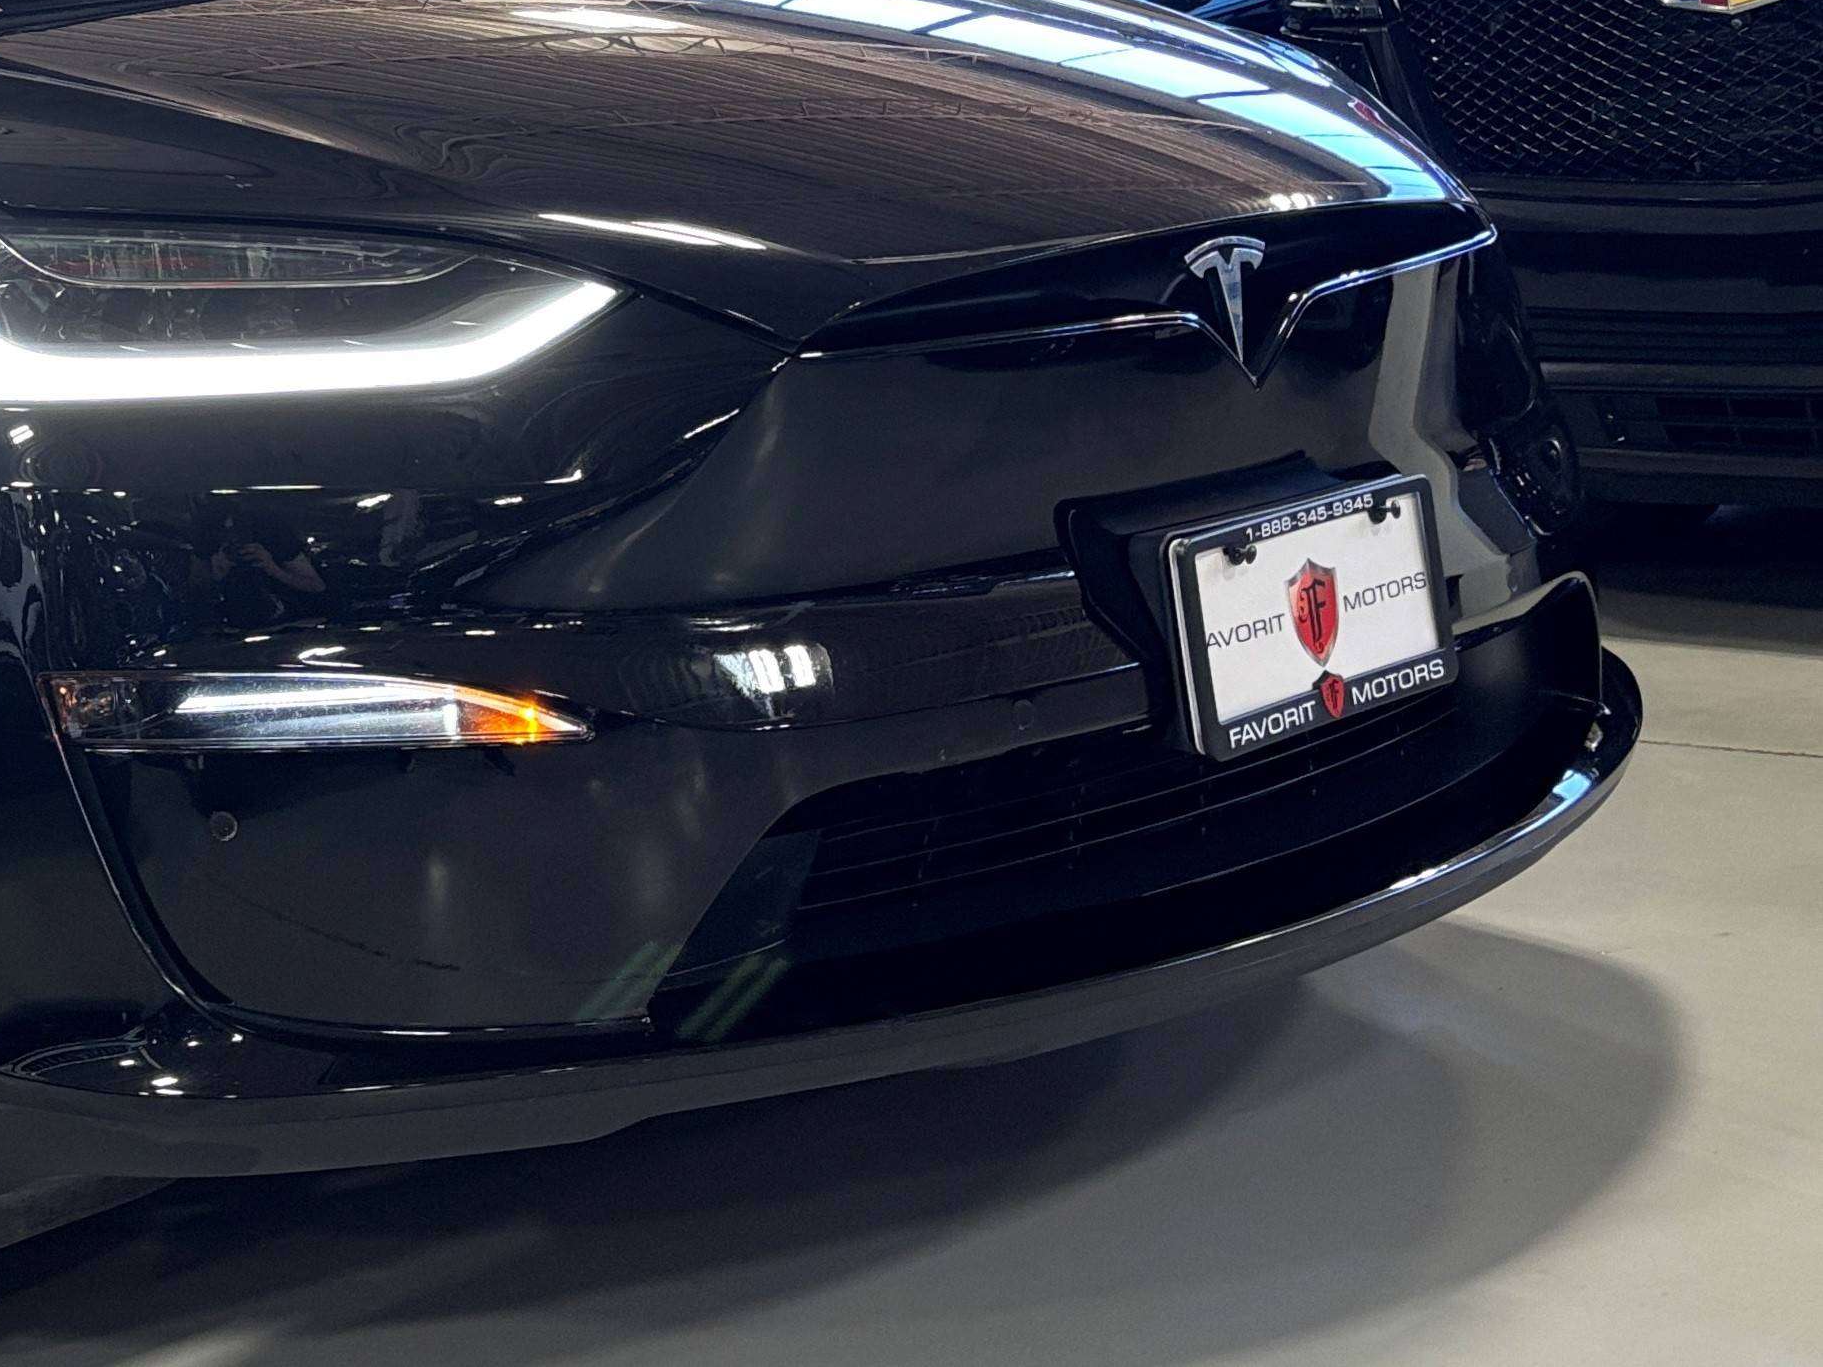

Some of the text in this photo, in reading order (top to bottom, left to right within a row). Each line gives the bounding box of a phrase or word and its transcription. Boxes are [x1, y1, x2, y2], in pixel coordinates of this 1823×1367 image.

[1244, 493, 1375, 542] 1-888-345-9345
[1342, 571, 1427, 613] MOTORS
[1228, 700, 1317, 749] FAVORIT
[1351, 658, 1446, 706] MOTORS
